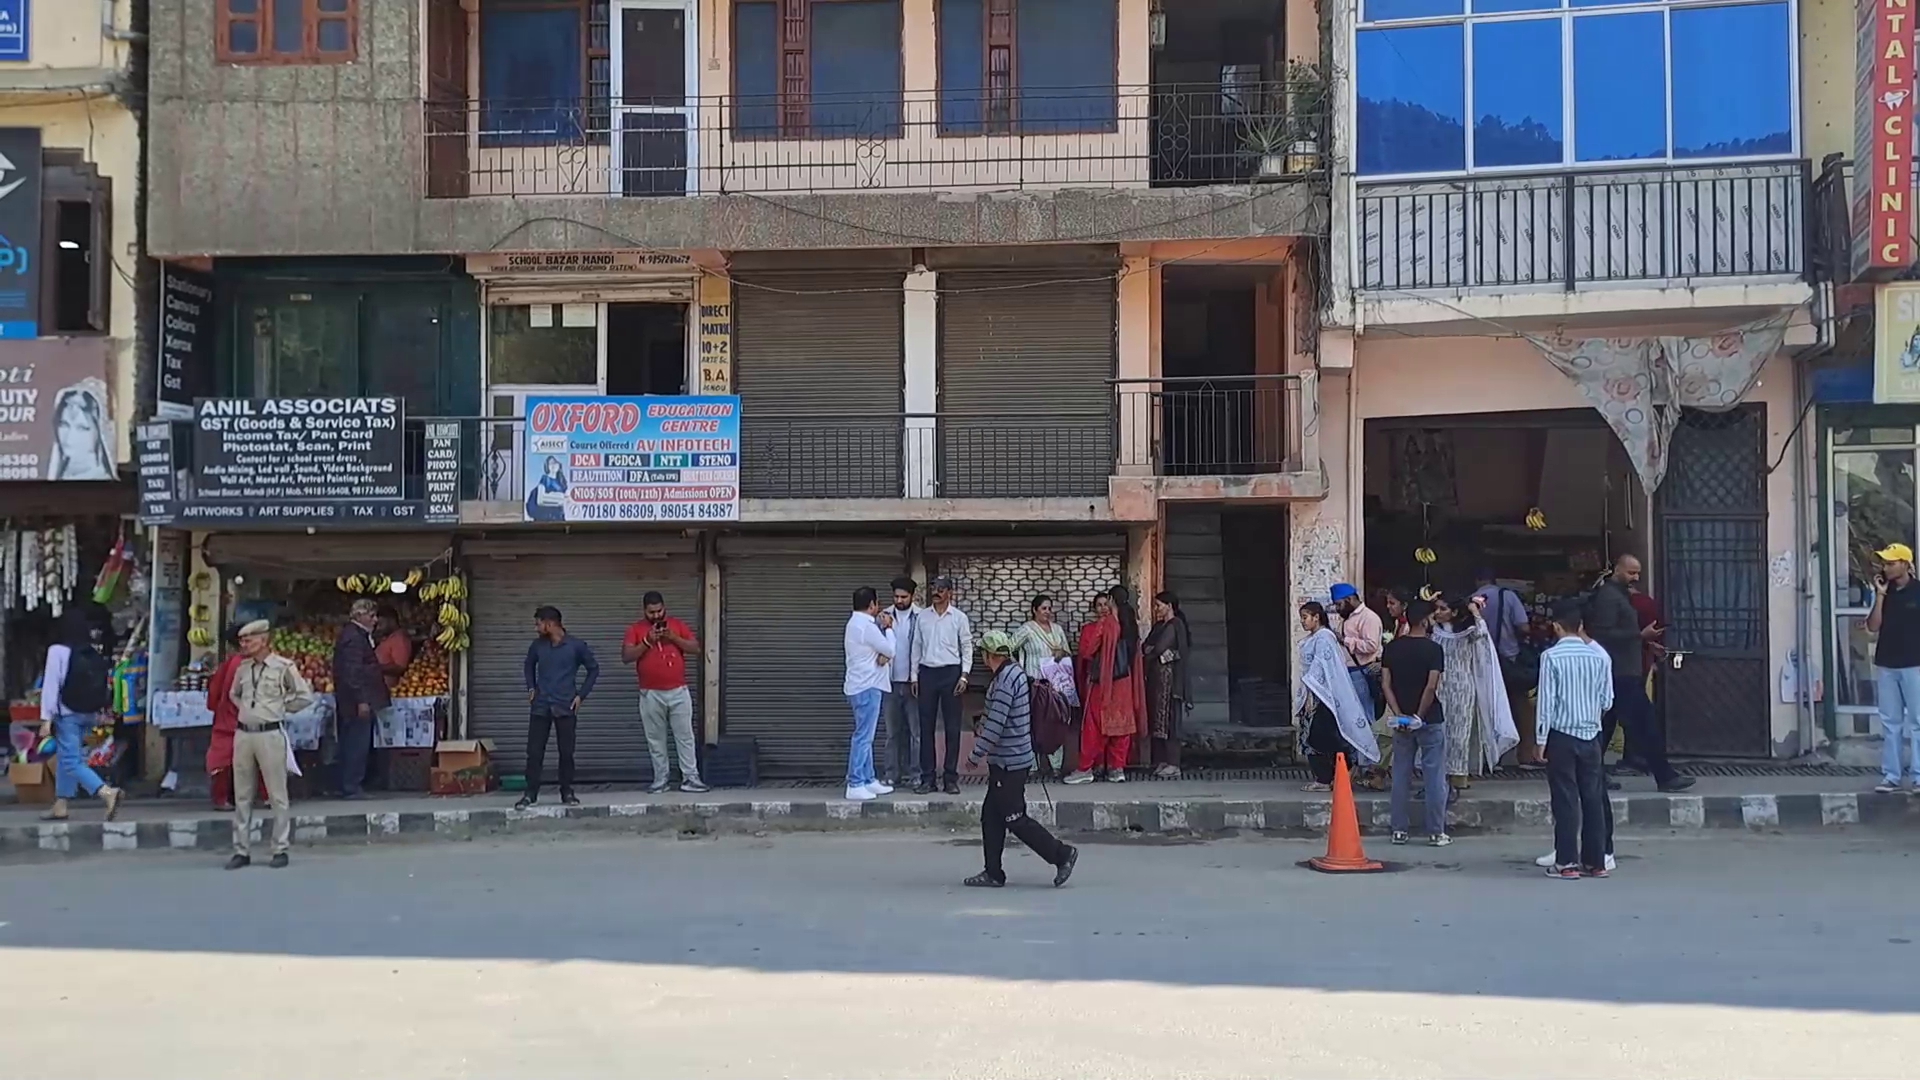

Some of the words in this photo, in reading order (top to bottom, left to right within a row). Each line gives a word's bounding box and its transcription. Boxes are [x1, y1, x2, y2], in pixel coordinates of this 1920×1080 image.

[1881, 115, 1903, 263] CLINIC
[508, 255, 542, 265] SCHOOL
[545, 255, 579, 265] BAZAR
[582, 254, 615, 265] MANDI
[701, 305, 729, 317] DIRECT
[165, 314, 196, 334] Colors
[165, 334, 192, 352] Xerox
[702, 341, 728, 354] 10+2
[164, 353, 182, 369] Tax
[163, 374, 182, 390] Gst
[200, 399, 256, 416] ANIL
[261, 397, 397, 415] ASSOCIATS
[647, 403, 733, 418] EDUCATION
[201, 417, 231, 431] GST
[233, 416, 286, 432] (Goods
[289, 416, 302, 430] &
[305, 415, 361, 429] Service
[364, 415, 396, 430] Tax)
[531, 402, 641, 435] OXFORD
[660, 419, 720, 433] CENTRE
[223, 431, 273, 441] Income
[276, 430, 307, 441] Tax/
[311, 430, 338, 440] Pan
[341, 429, 374, 440] Card
[223, 441, 293, 453] Photostat,
[296, 441, 334, 452] Scan,
[338, 440, 372, 451] Print
[433, 438, 451, 448] PAN
[570, 440, 598, 450] Course
[636, 438, 656, 452] AV
[660, 438, 731, 452] INFOTECH
[236, 453, 267, 464] Contact
[268, 453, 280, 463] for
[287, 453, 312, 463] school
[313, 454, 335, 463] event
[336, 452, 357, 463] dress
[427, 449, 456, 459] CARD/
[574, 454, 596, 466] DCA
[608, 454, 642, 467] PGDCA
[660, 454, 683, 467] NTT
[698, 454, 732, 467] STENO
[257, 464, 272, 474] Led
[322, 463, 345, 473] Video
[346, 462, 393, 475] Background
[427, 460, 457, 470] PHOTO
[220, 475, 238, 485] Wall
[360, 474, 376, 483] etc.
[426, 471, 457, 481] STATE/
[571, 469, 623, 481] BEAUTITION
[629, 470, 650, 482] DFA
[428, 482, 455, 492] PRINT
[573, 486, 614, 500] NIOS/SOS
[615, 487, 662, 501] (10th/12th)
[663, 487, 708, 499] Admissions
[709, 486, 733, 498] OPEN
[430, 493, 453, 505] OUT/
[183, 506, 243, 517] ARTWORKS
[258, 506, 280, 516] ART
[282, 506, 334, 516] SUPPLIES
[352, 506, 374, 516] TAX
[393, 506, 415, 516] GST
[429, 504, 454, 514] SCAN
[582, 503, 616, 519] 70180
[619, 503, 658, 521] 86309,
[660, 503, 695, 518] 98054
[698, 502, 733, 518] 84387
